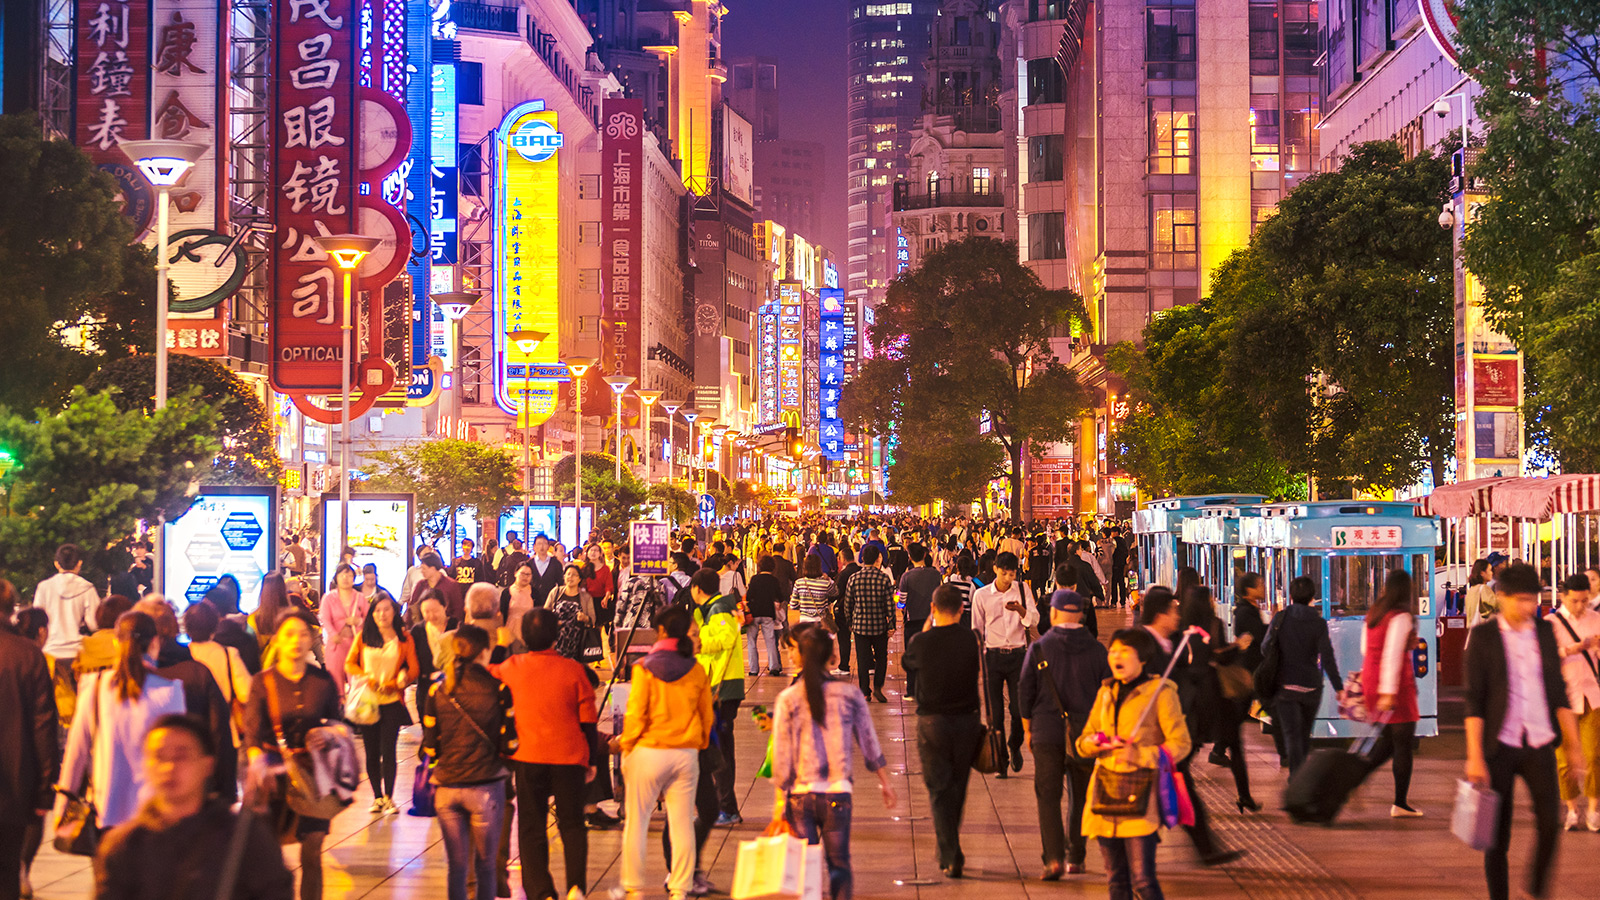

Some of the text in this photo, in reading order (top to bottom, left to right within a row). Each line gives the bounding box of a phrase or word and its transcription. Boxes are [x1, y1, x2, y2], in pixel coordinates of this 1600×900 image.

[86, 0, 134, 150] 利鐘表
[512, 135, 562, 147] BAC
[612, 149, 631, 311] 上海市第一食品商店
[699, 240, 719, 248] TITONI
[281, 346, 344, 362] OPTICAL
[614, 353, 627, 376] Foo
[634, 524, 668, 545] 快照
[1354, 530, 1397, 540] 观光车
[1422, 599, 1428, 613] 2
